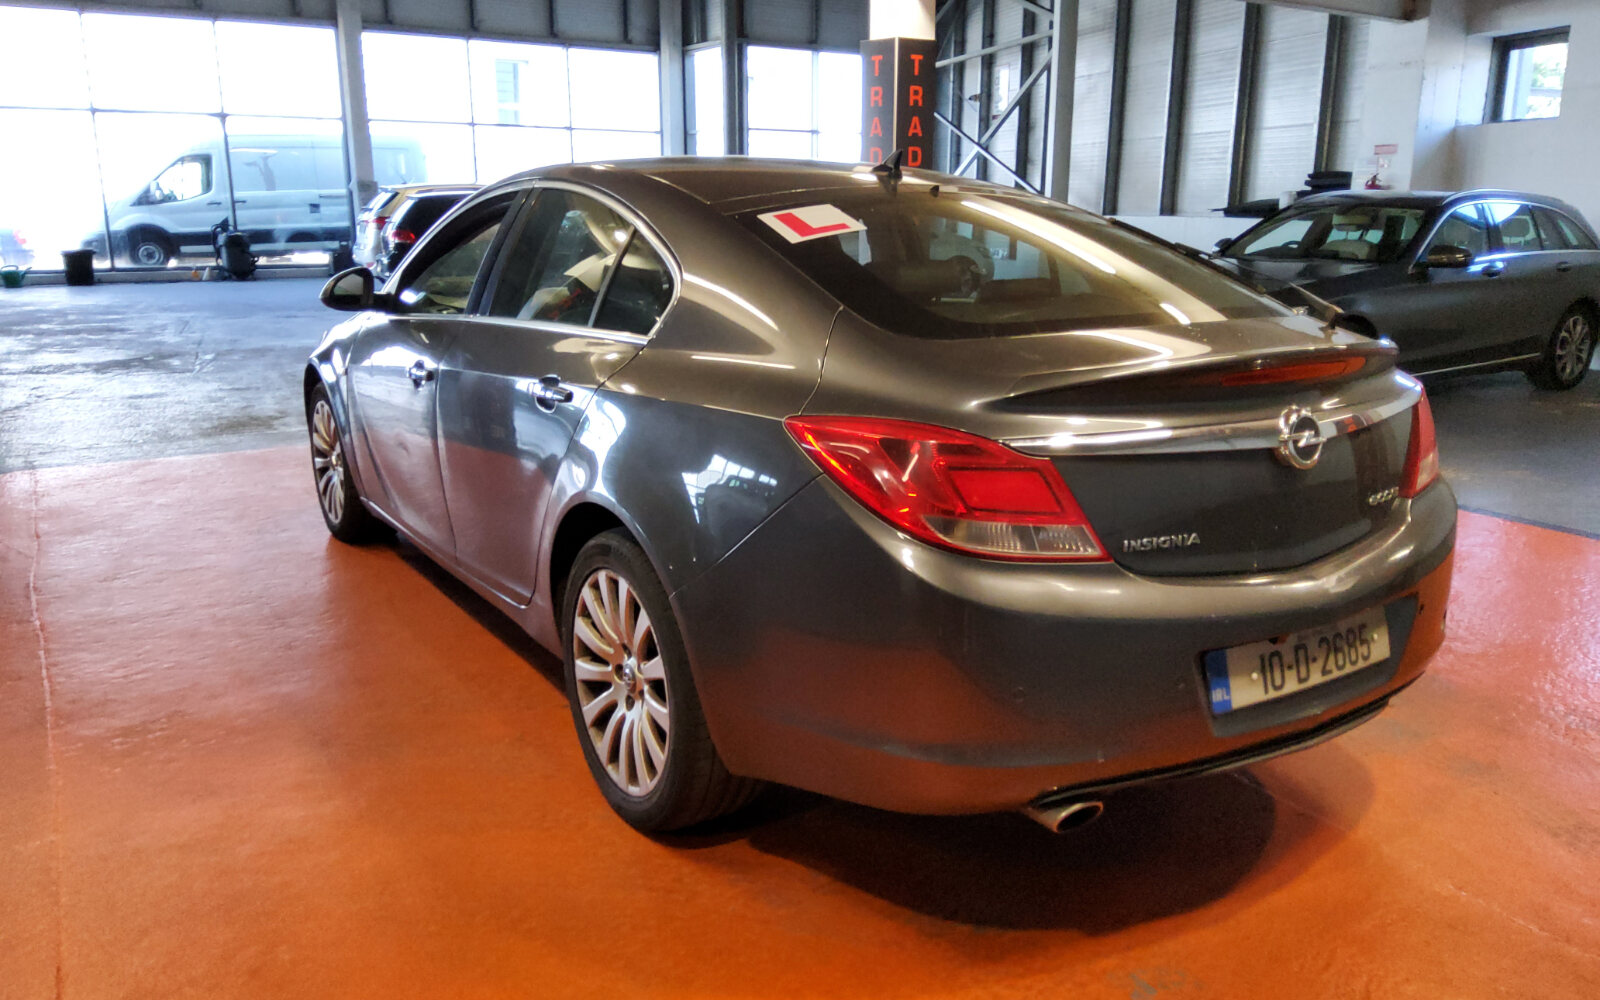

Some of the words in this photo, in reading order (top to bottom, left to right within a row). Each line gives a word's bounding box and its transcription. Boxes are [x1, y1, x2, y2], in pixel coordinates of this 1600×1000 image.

[907, 53, 924, 168] TRAD
[772, 211, 852, 238] L
[1122, 532, 1201, 553] INSIGNIA
[1259, 623, 1372, 695] 10-D-2685
[1211, 687, 1230, 703] IRL
